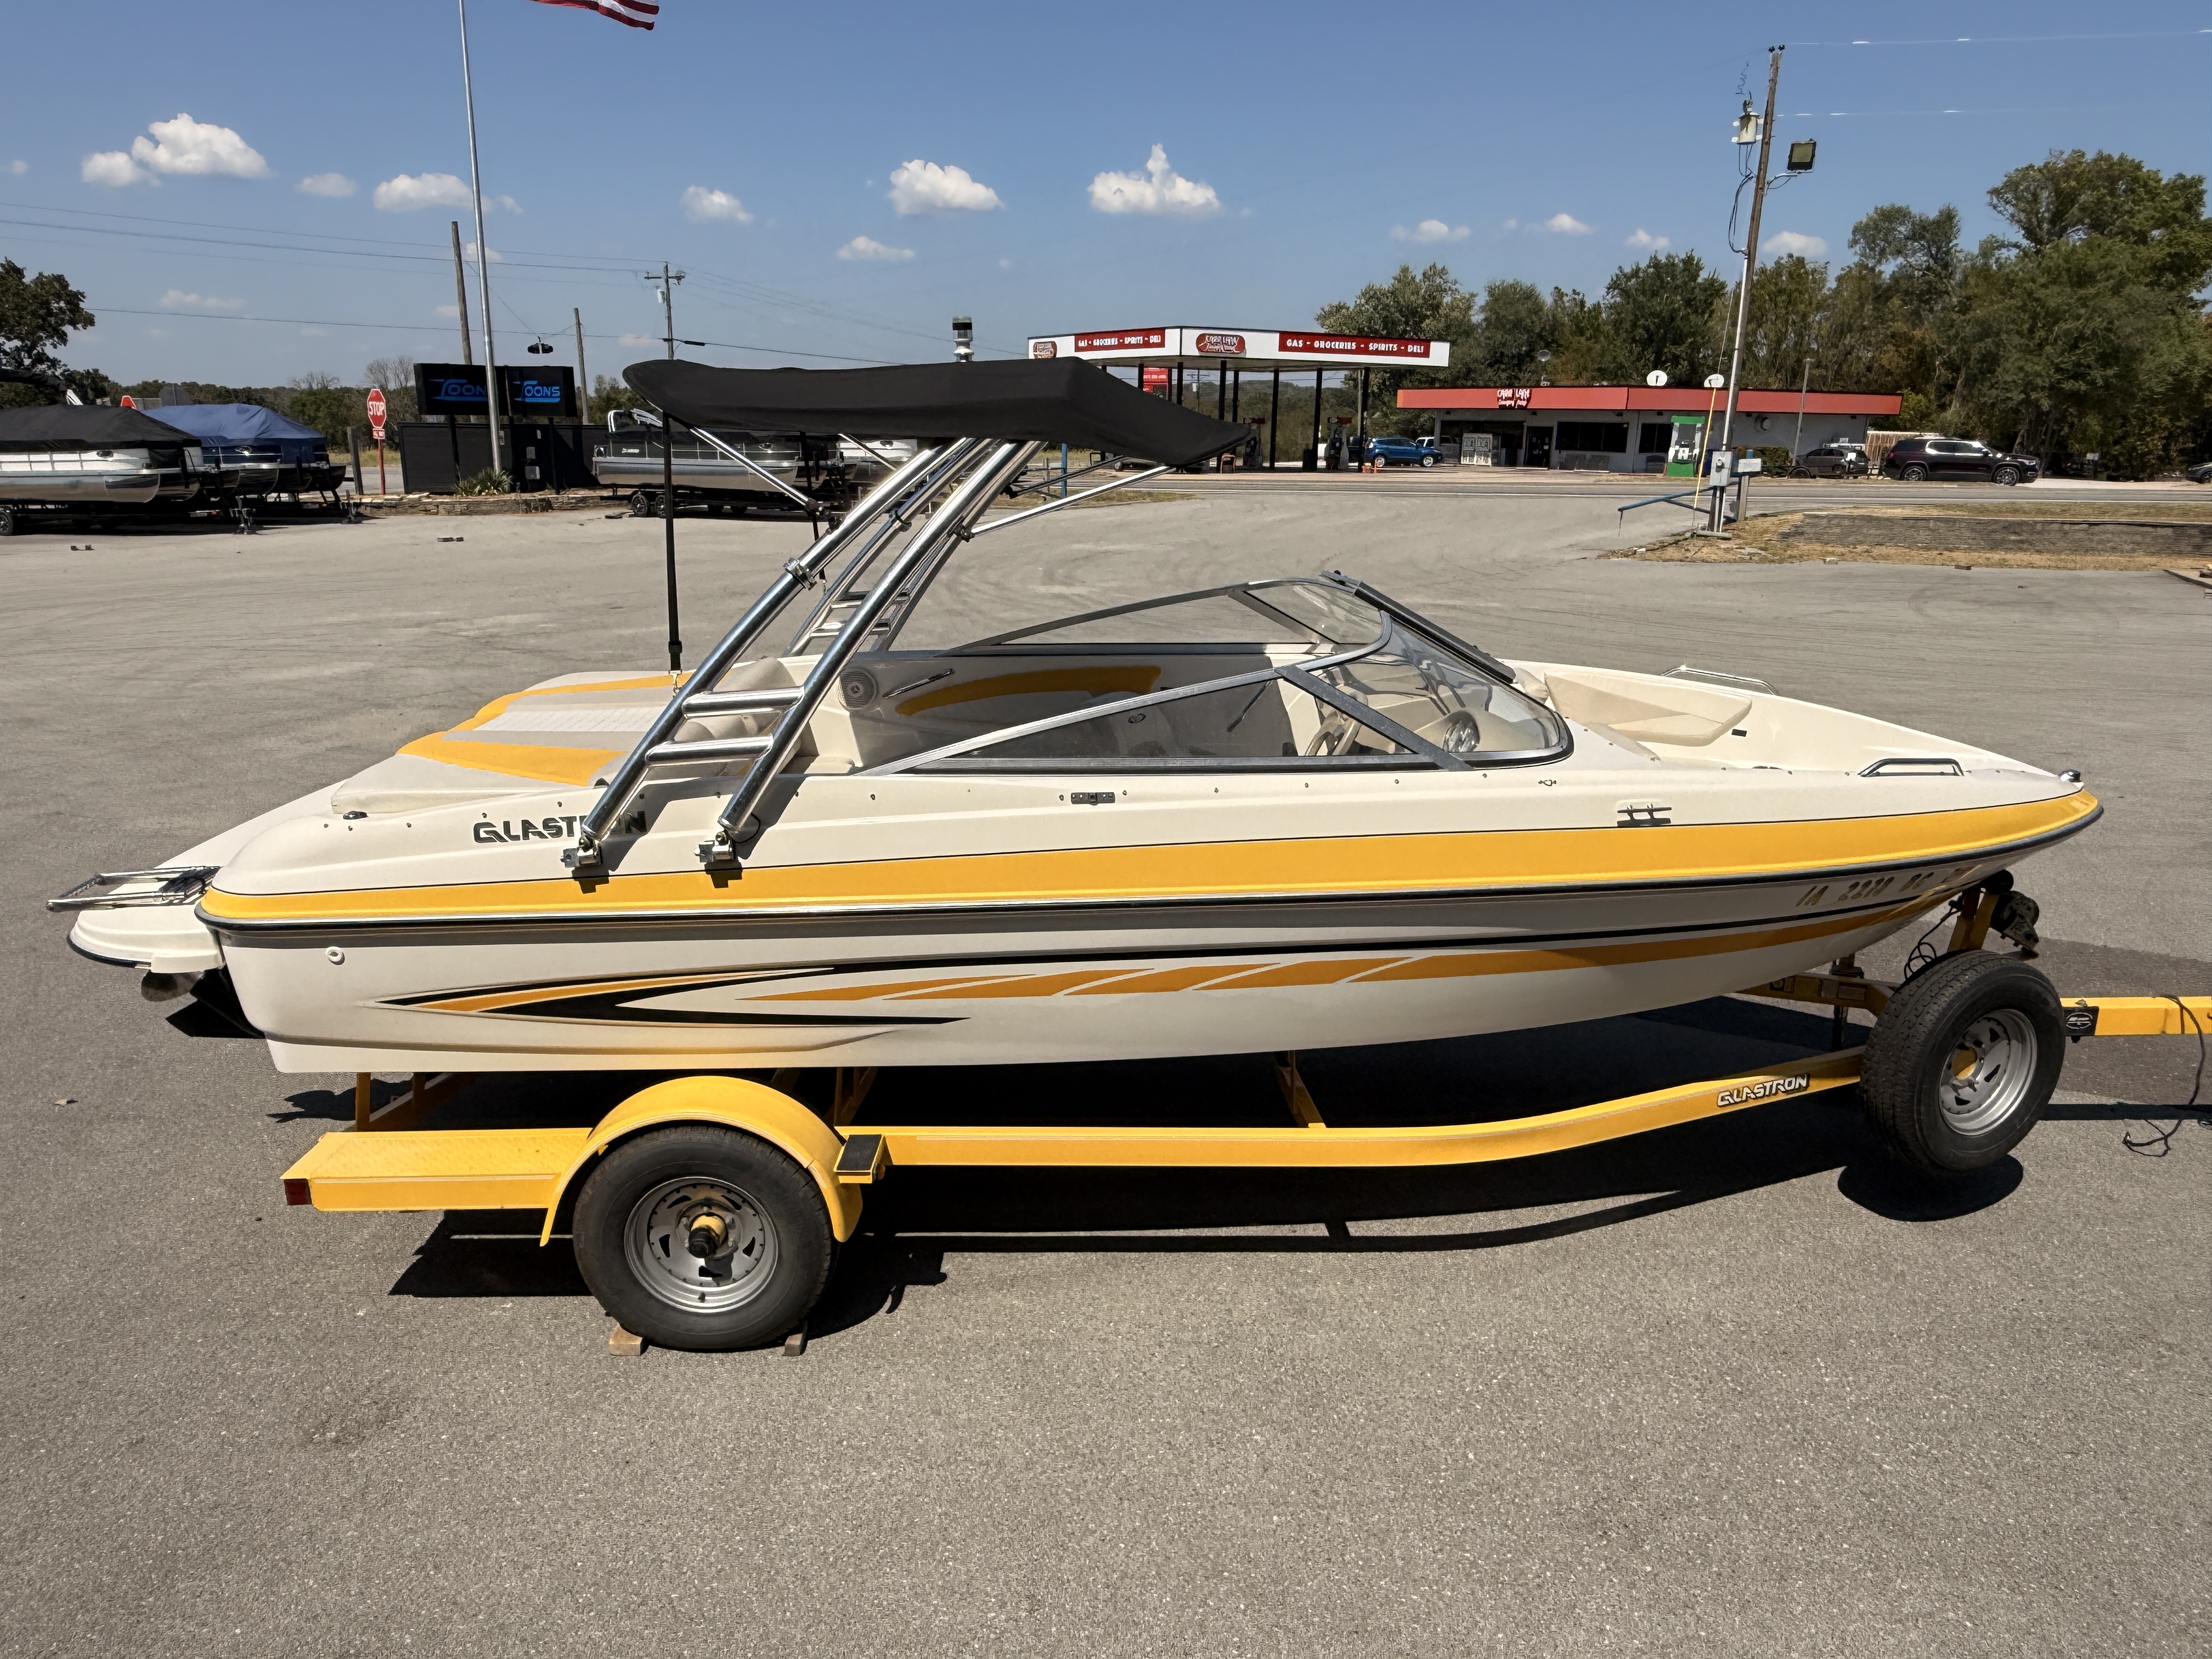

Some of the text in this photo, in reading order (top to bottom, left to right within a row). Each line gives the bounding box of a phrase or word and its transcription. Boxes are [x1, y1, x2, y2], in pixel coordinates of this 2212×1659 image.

[1286, 339, 1304, 348] GAS
[1369, 342, 1398, 351] SPIRITS
[368, 401, 385, 416] STOP
[473, 810, 648, 844] GLASTN
[1717, 1073, 1809, 1107] GLASTRON
